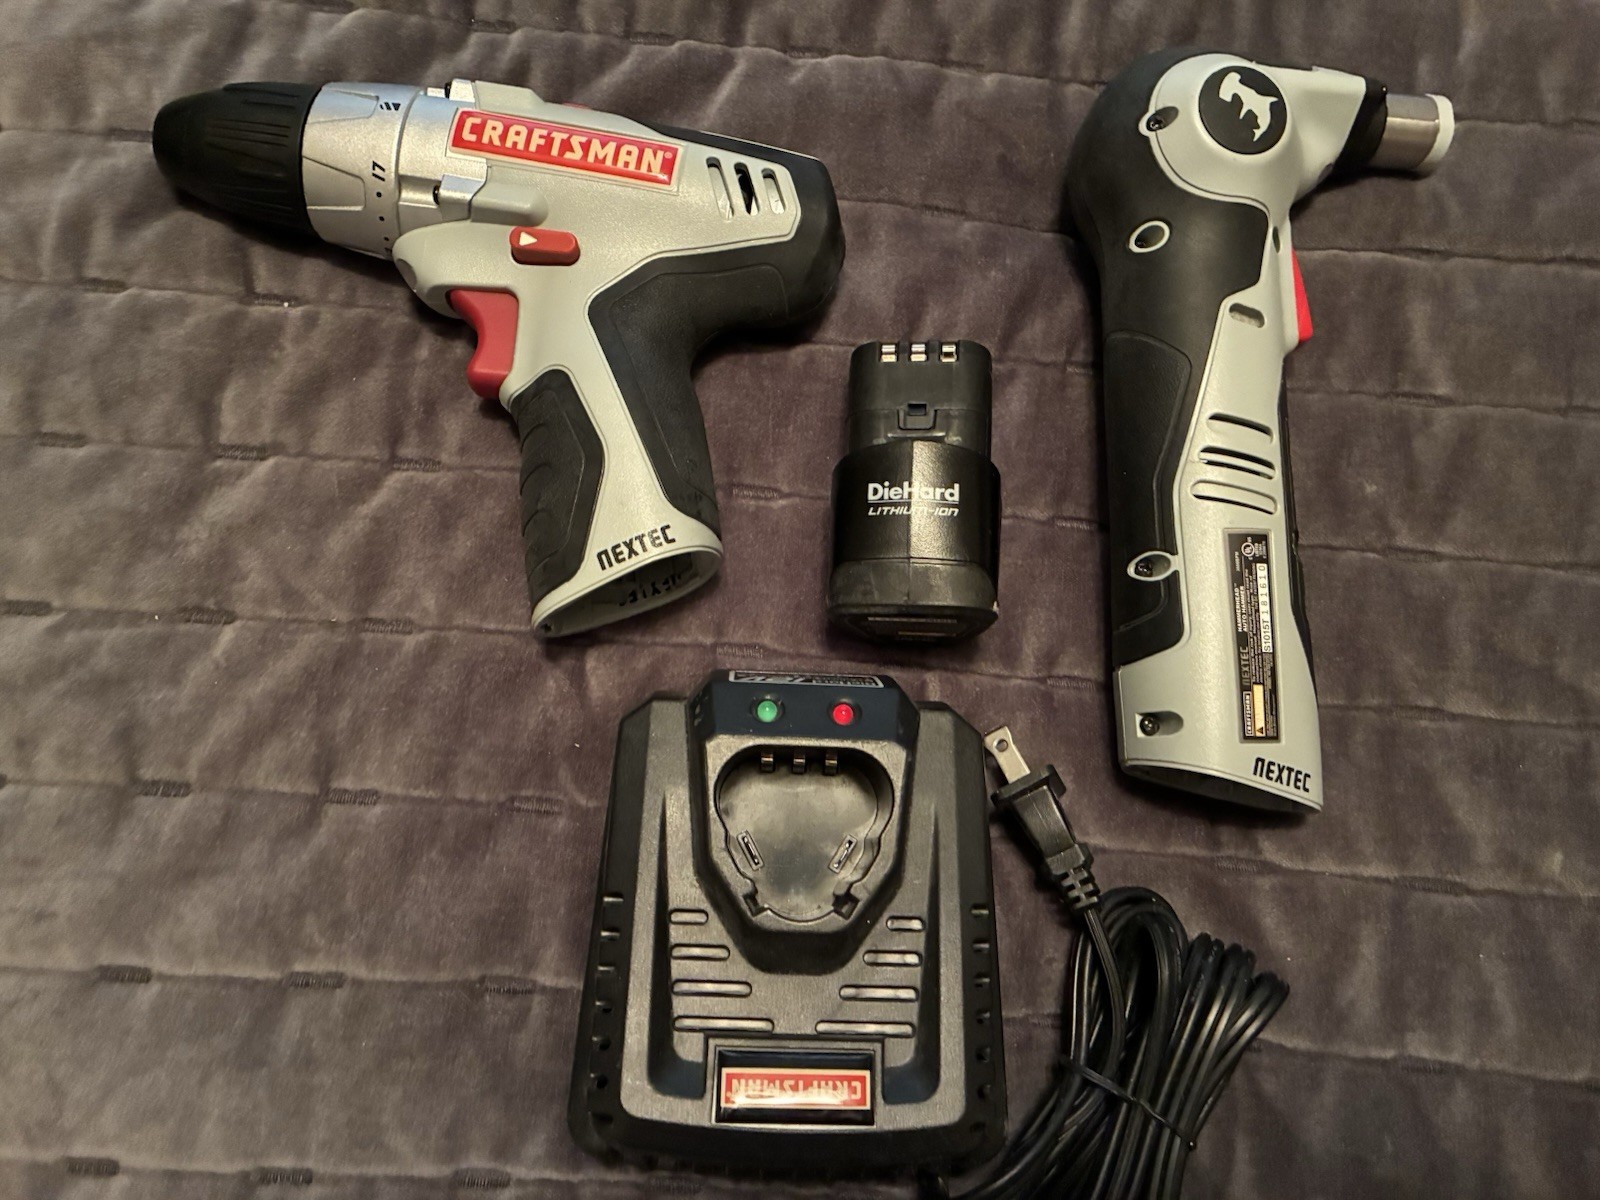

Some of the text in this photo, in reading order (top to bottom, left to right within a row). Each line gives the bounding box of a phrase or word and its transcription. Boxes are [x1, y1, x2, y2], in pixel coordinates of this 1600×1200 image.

[461, 116, 664, 174] CRAFTSMAN
[867, 481, 960, 502] DieHard
[596, 524, 676, 571] NEXTEC
[1262, 619, 1271, 652] S1015T
[1252, 757, 1311, 793] NEXTEC
